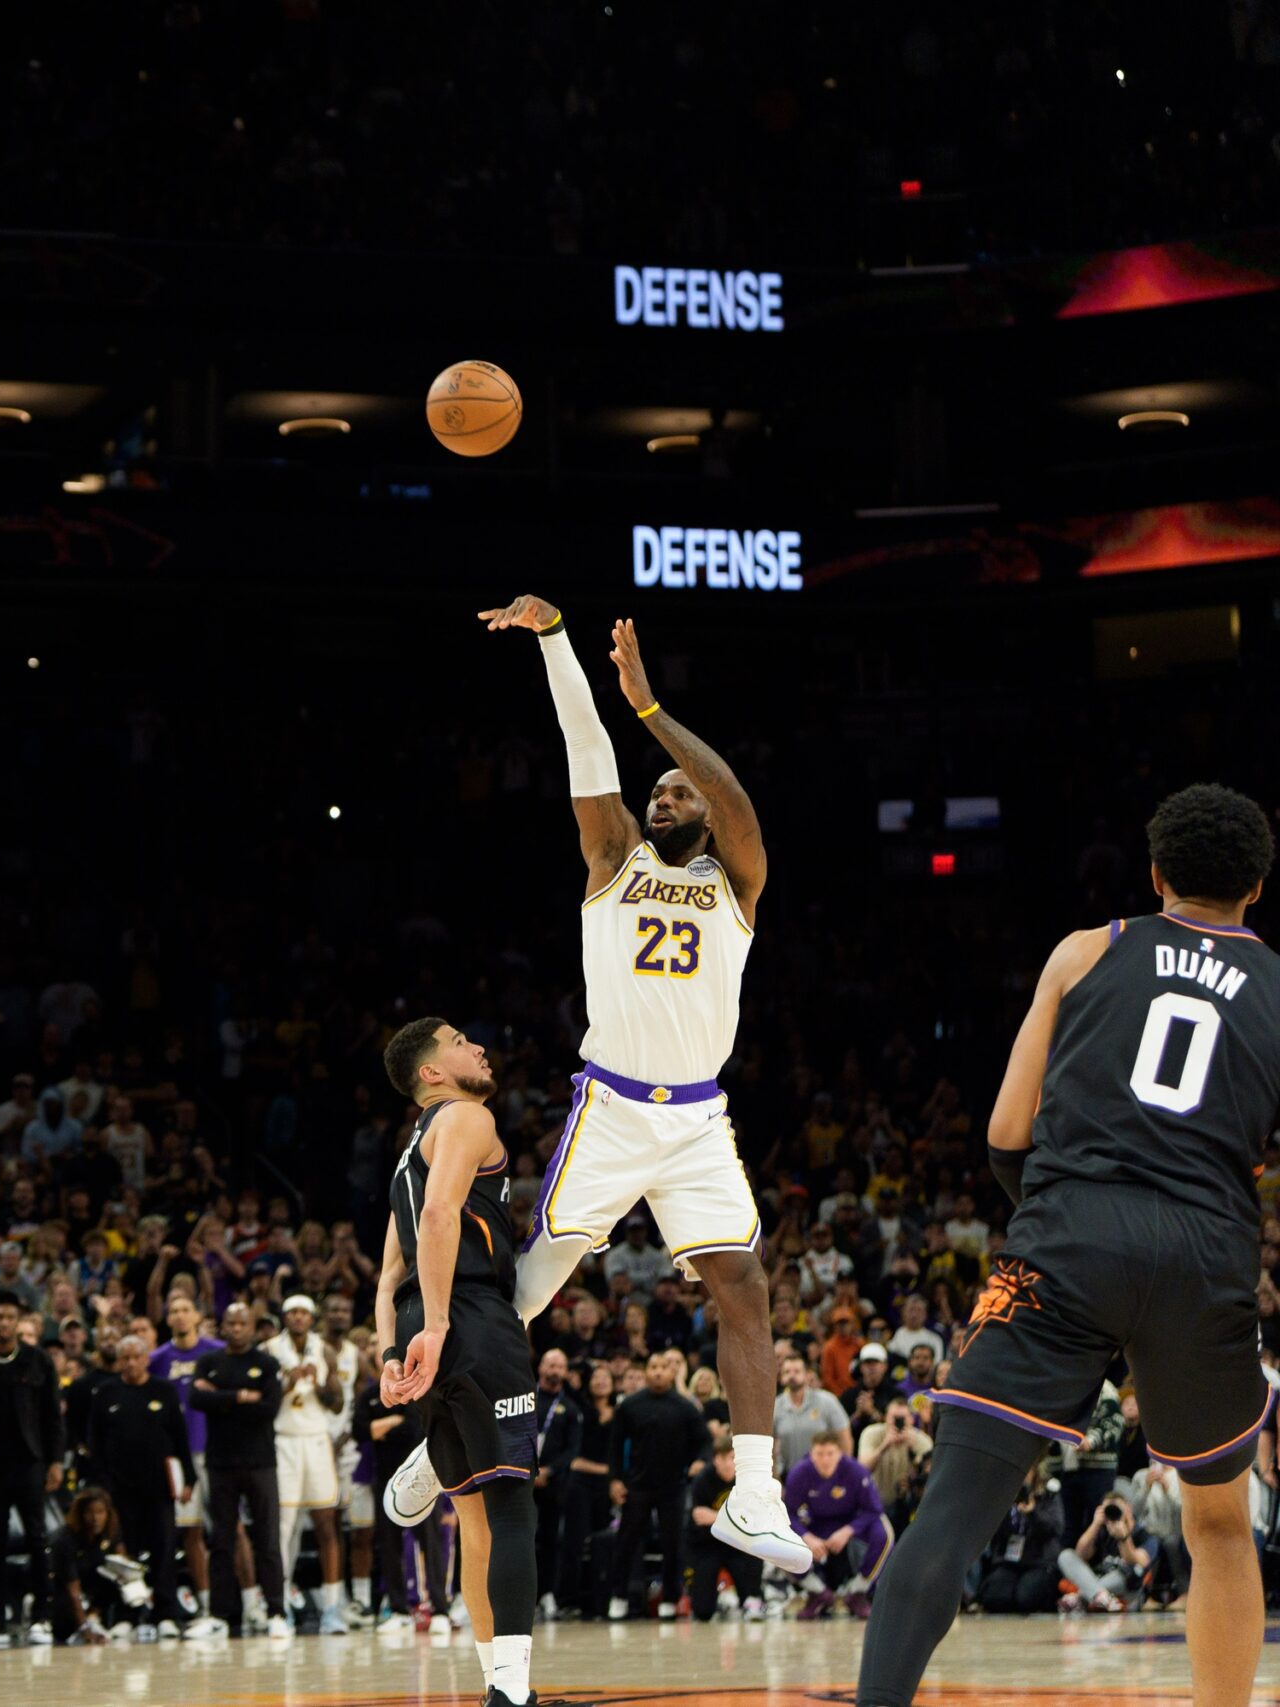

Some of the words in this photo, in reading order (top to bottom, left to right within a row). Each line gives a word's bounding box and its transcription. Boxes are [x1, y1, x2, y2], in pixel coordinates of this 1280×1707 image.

[614, 264, 785, 332] DEFENSE
[632, 525, 803, 591] DEFENSE
[619, 870, 718, 911] LAKERS
[633, 914, 701, 980] 23
[1155, 944, 1248, 1001] DUNN
[1129, 991, 1222, 1117] 0
